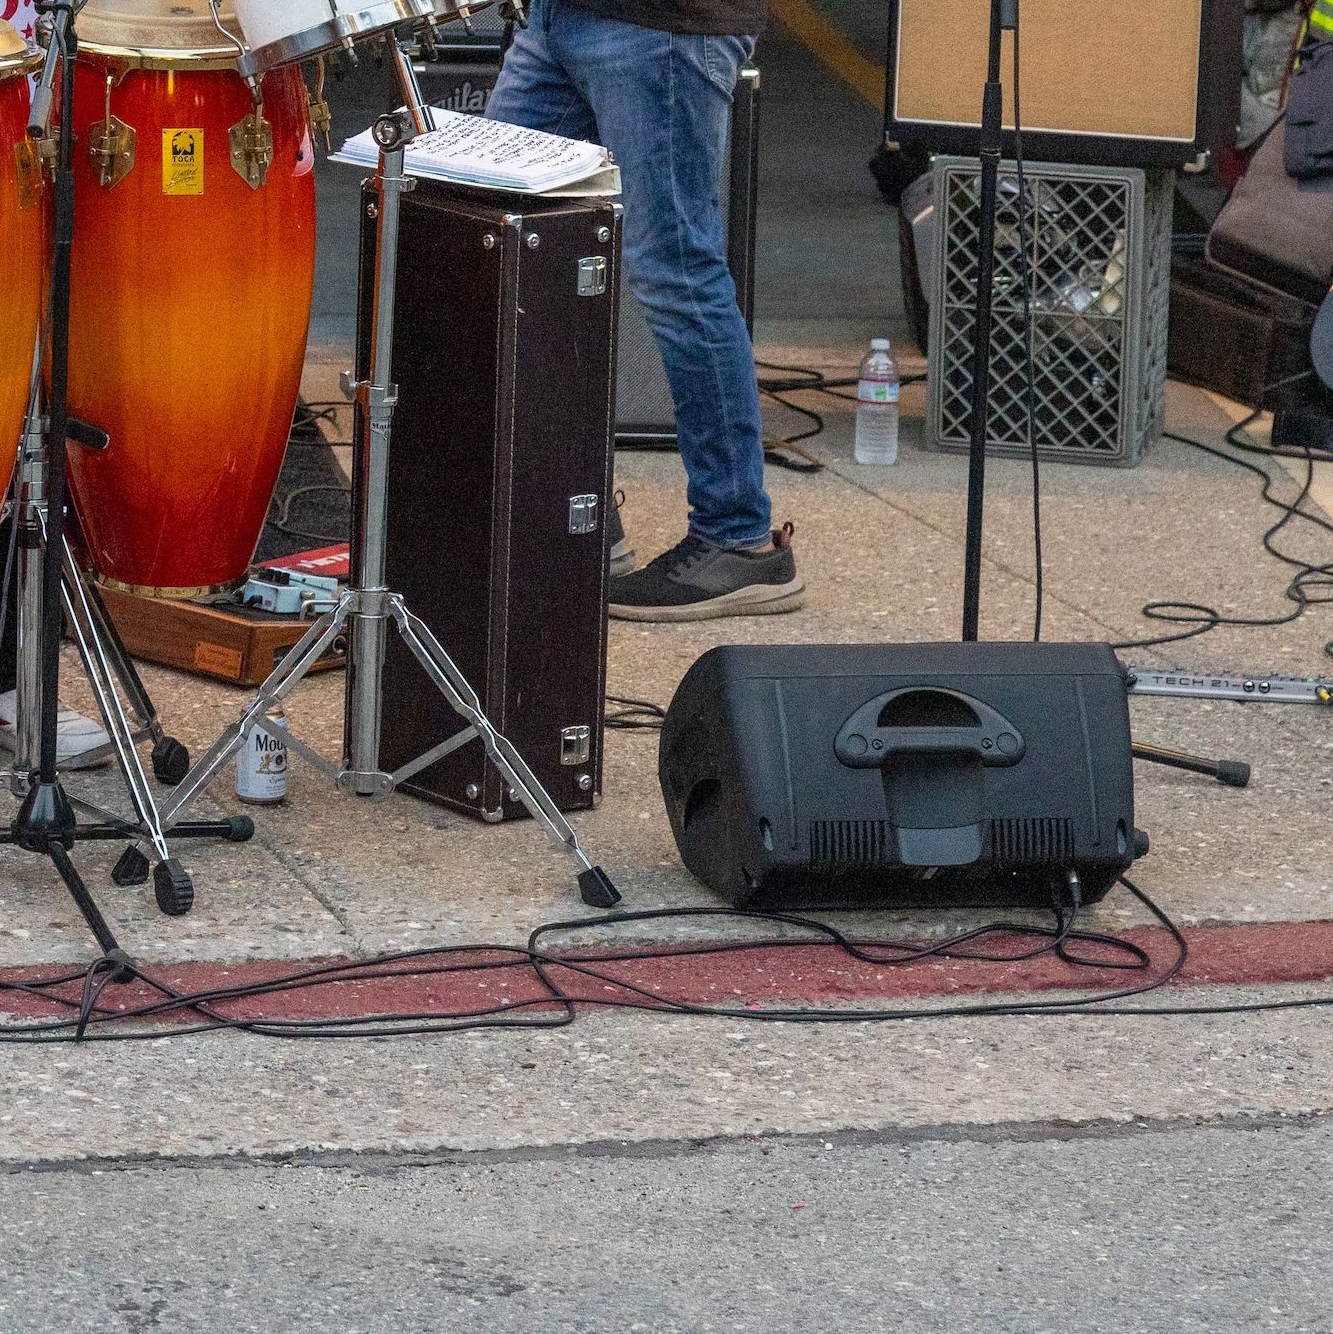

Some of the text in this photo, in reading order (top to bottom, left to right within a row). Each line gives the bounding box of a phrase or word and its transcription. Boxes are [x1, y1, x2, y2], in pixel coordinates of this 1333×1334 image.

[173, 155, 194, 163] TOCA
[1152, 675, 1229, 688] TECH 21
